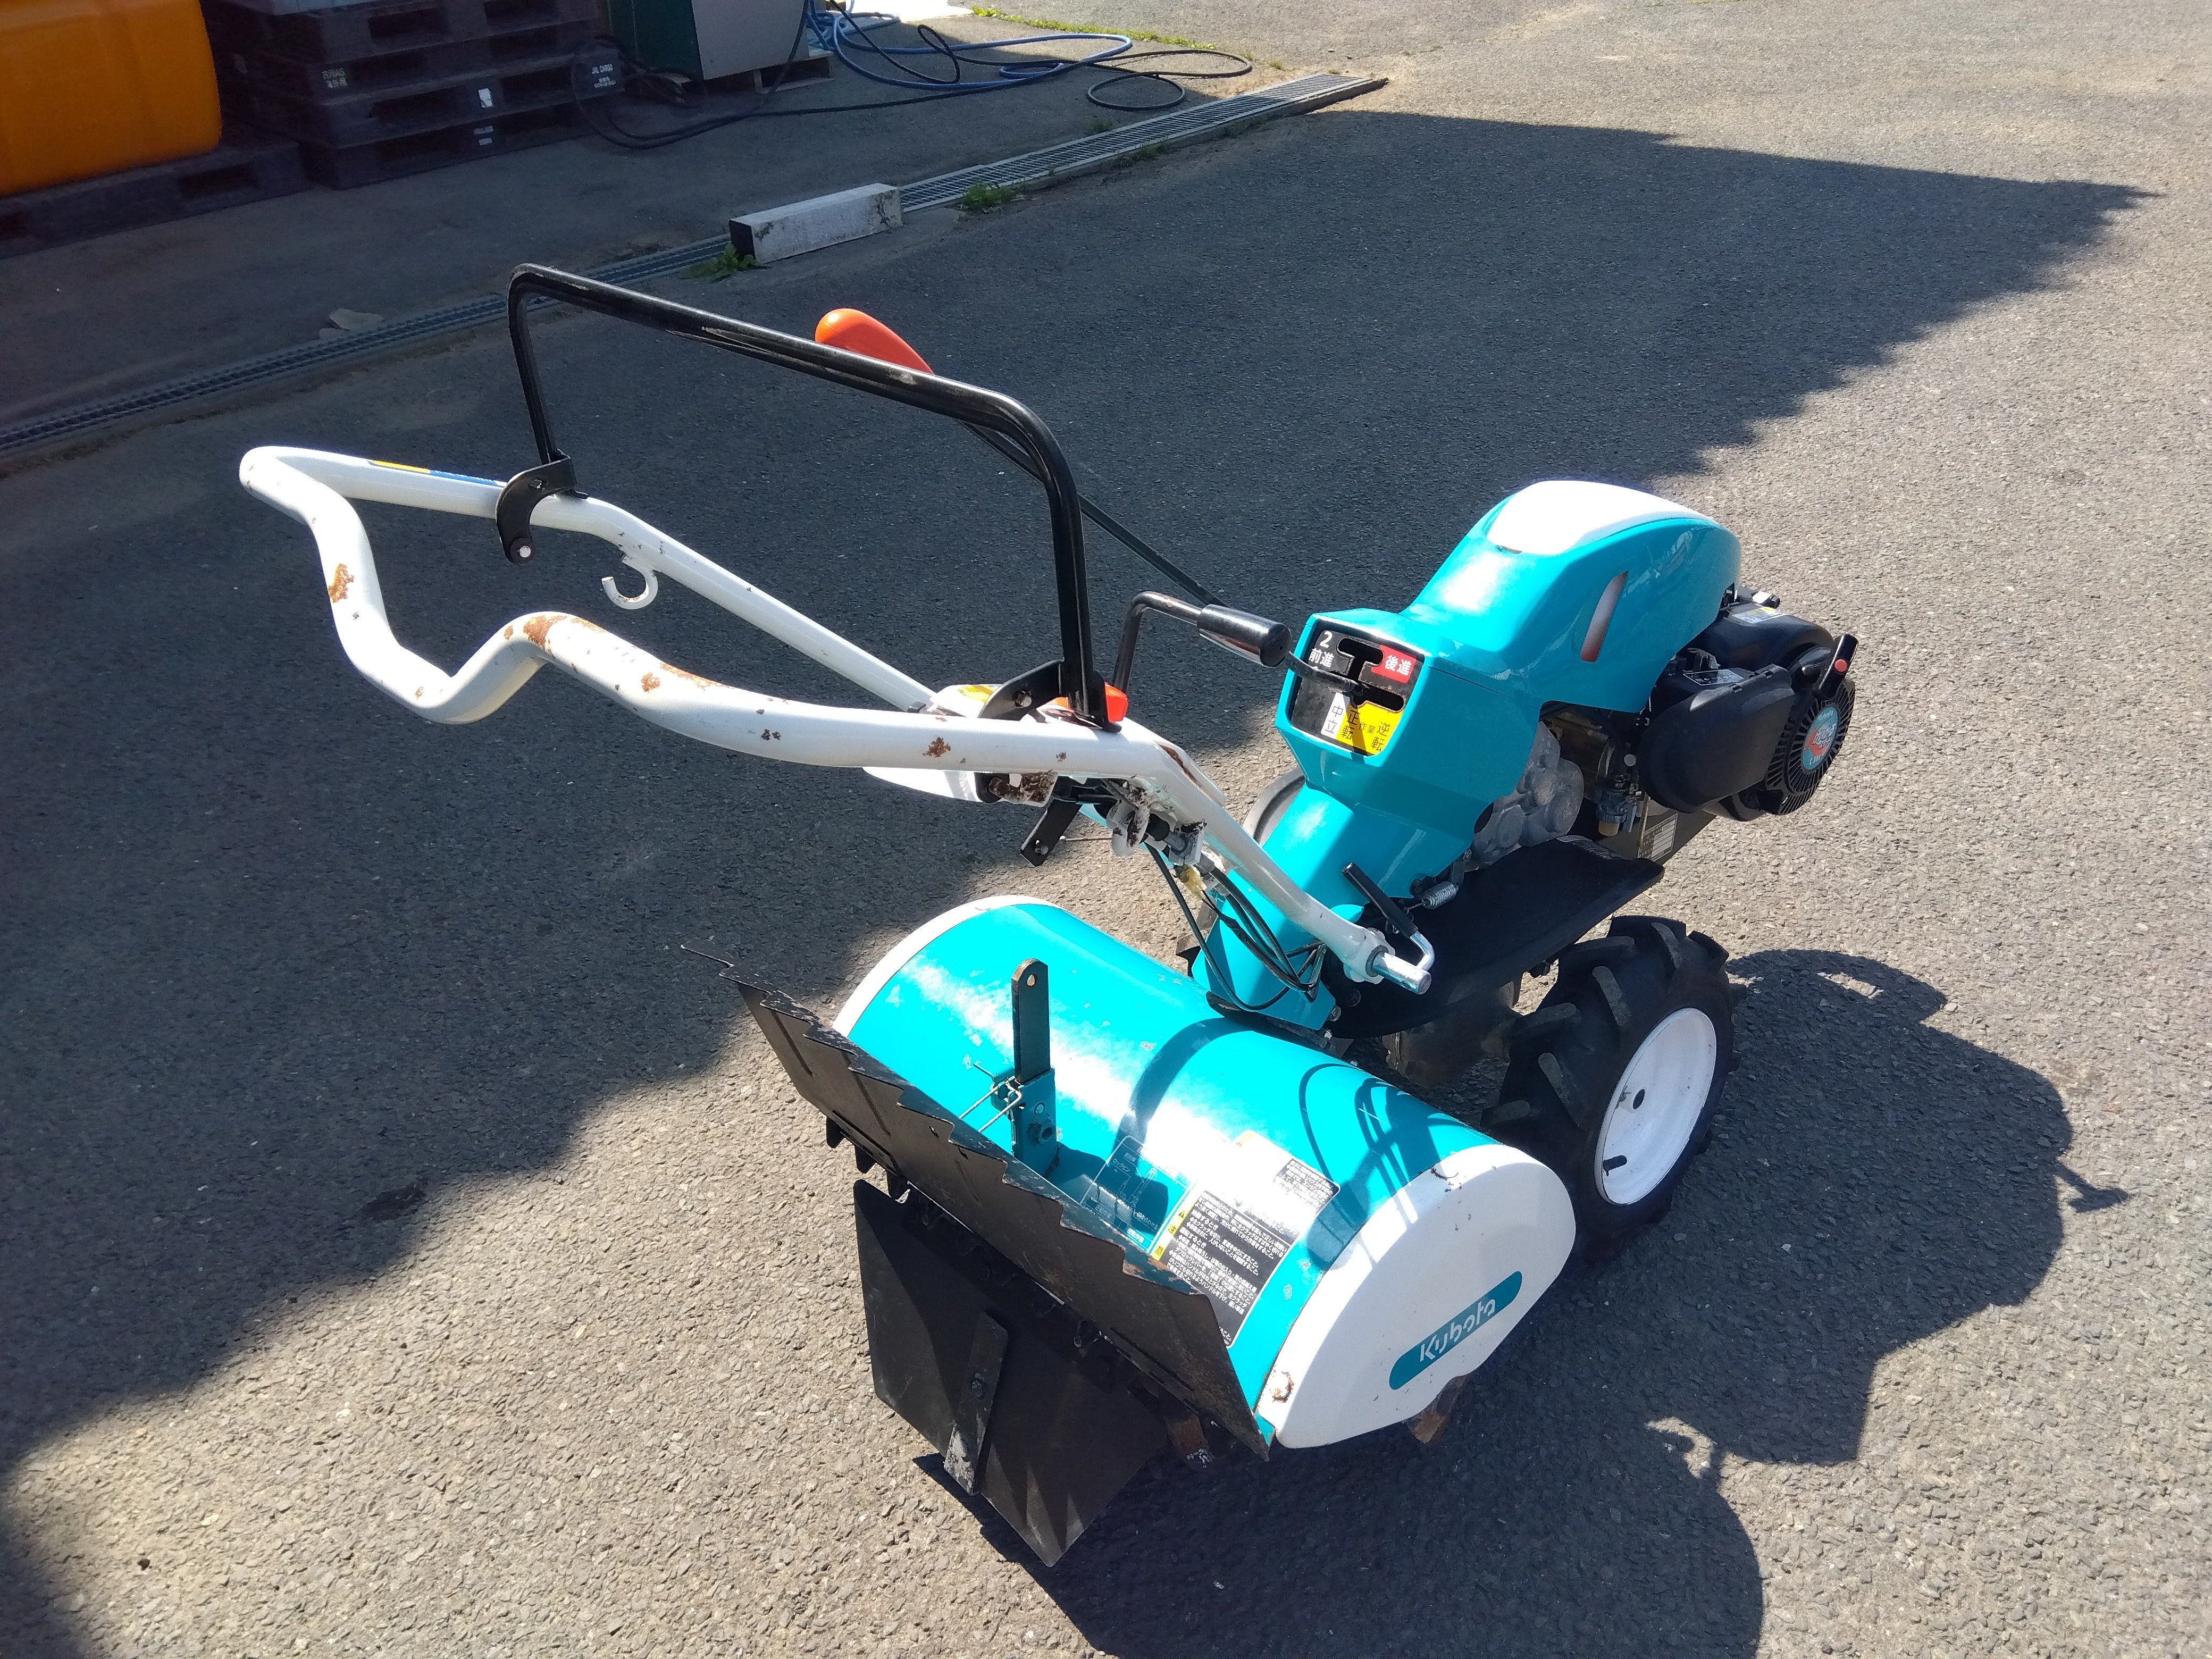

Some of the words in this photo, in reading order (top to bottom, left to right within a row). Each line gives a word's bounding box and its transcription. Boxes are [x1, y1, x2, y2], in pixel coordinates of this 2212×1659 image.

[1319, 631, 1333, 648] 2
[1308, 648, 1335, 668] 前進
[1385, 655, 1412, 676] 後進
[1325, 705, 1343, 734] 中立
[1341, 709, 1361, 740] 正転
[1358, 722, 1376, 734] 作業
[1371, 721, 1391, 752] 逆転
[1112, 1158, 1131, 1172] ロックピン
[1155, 1224, 1177, 1256] 注意
[1419, 1298, 1496, 1362] Kubota
